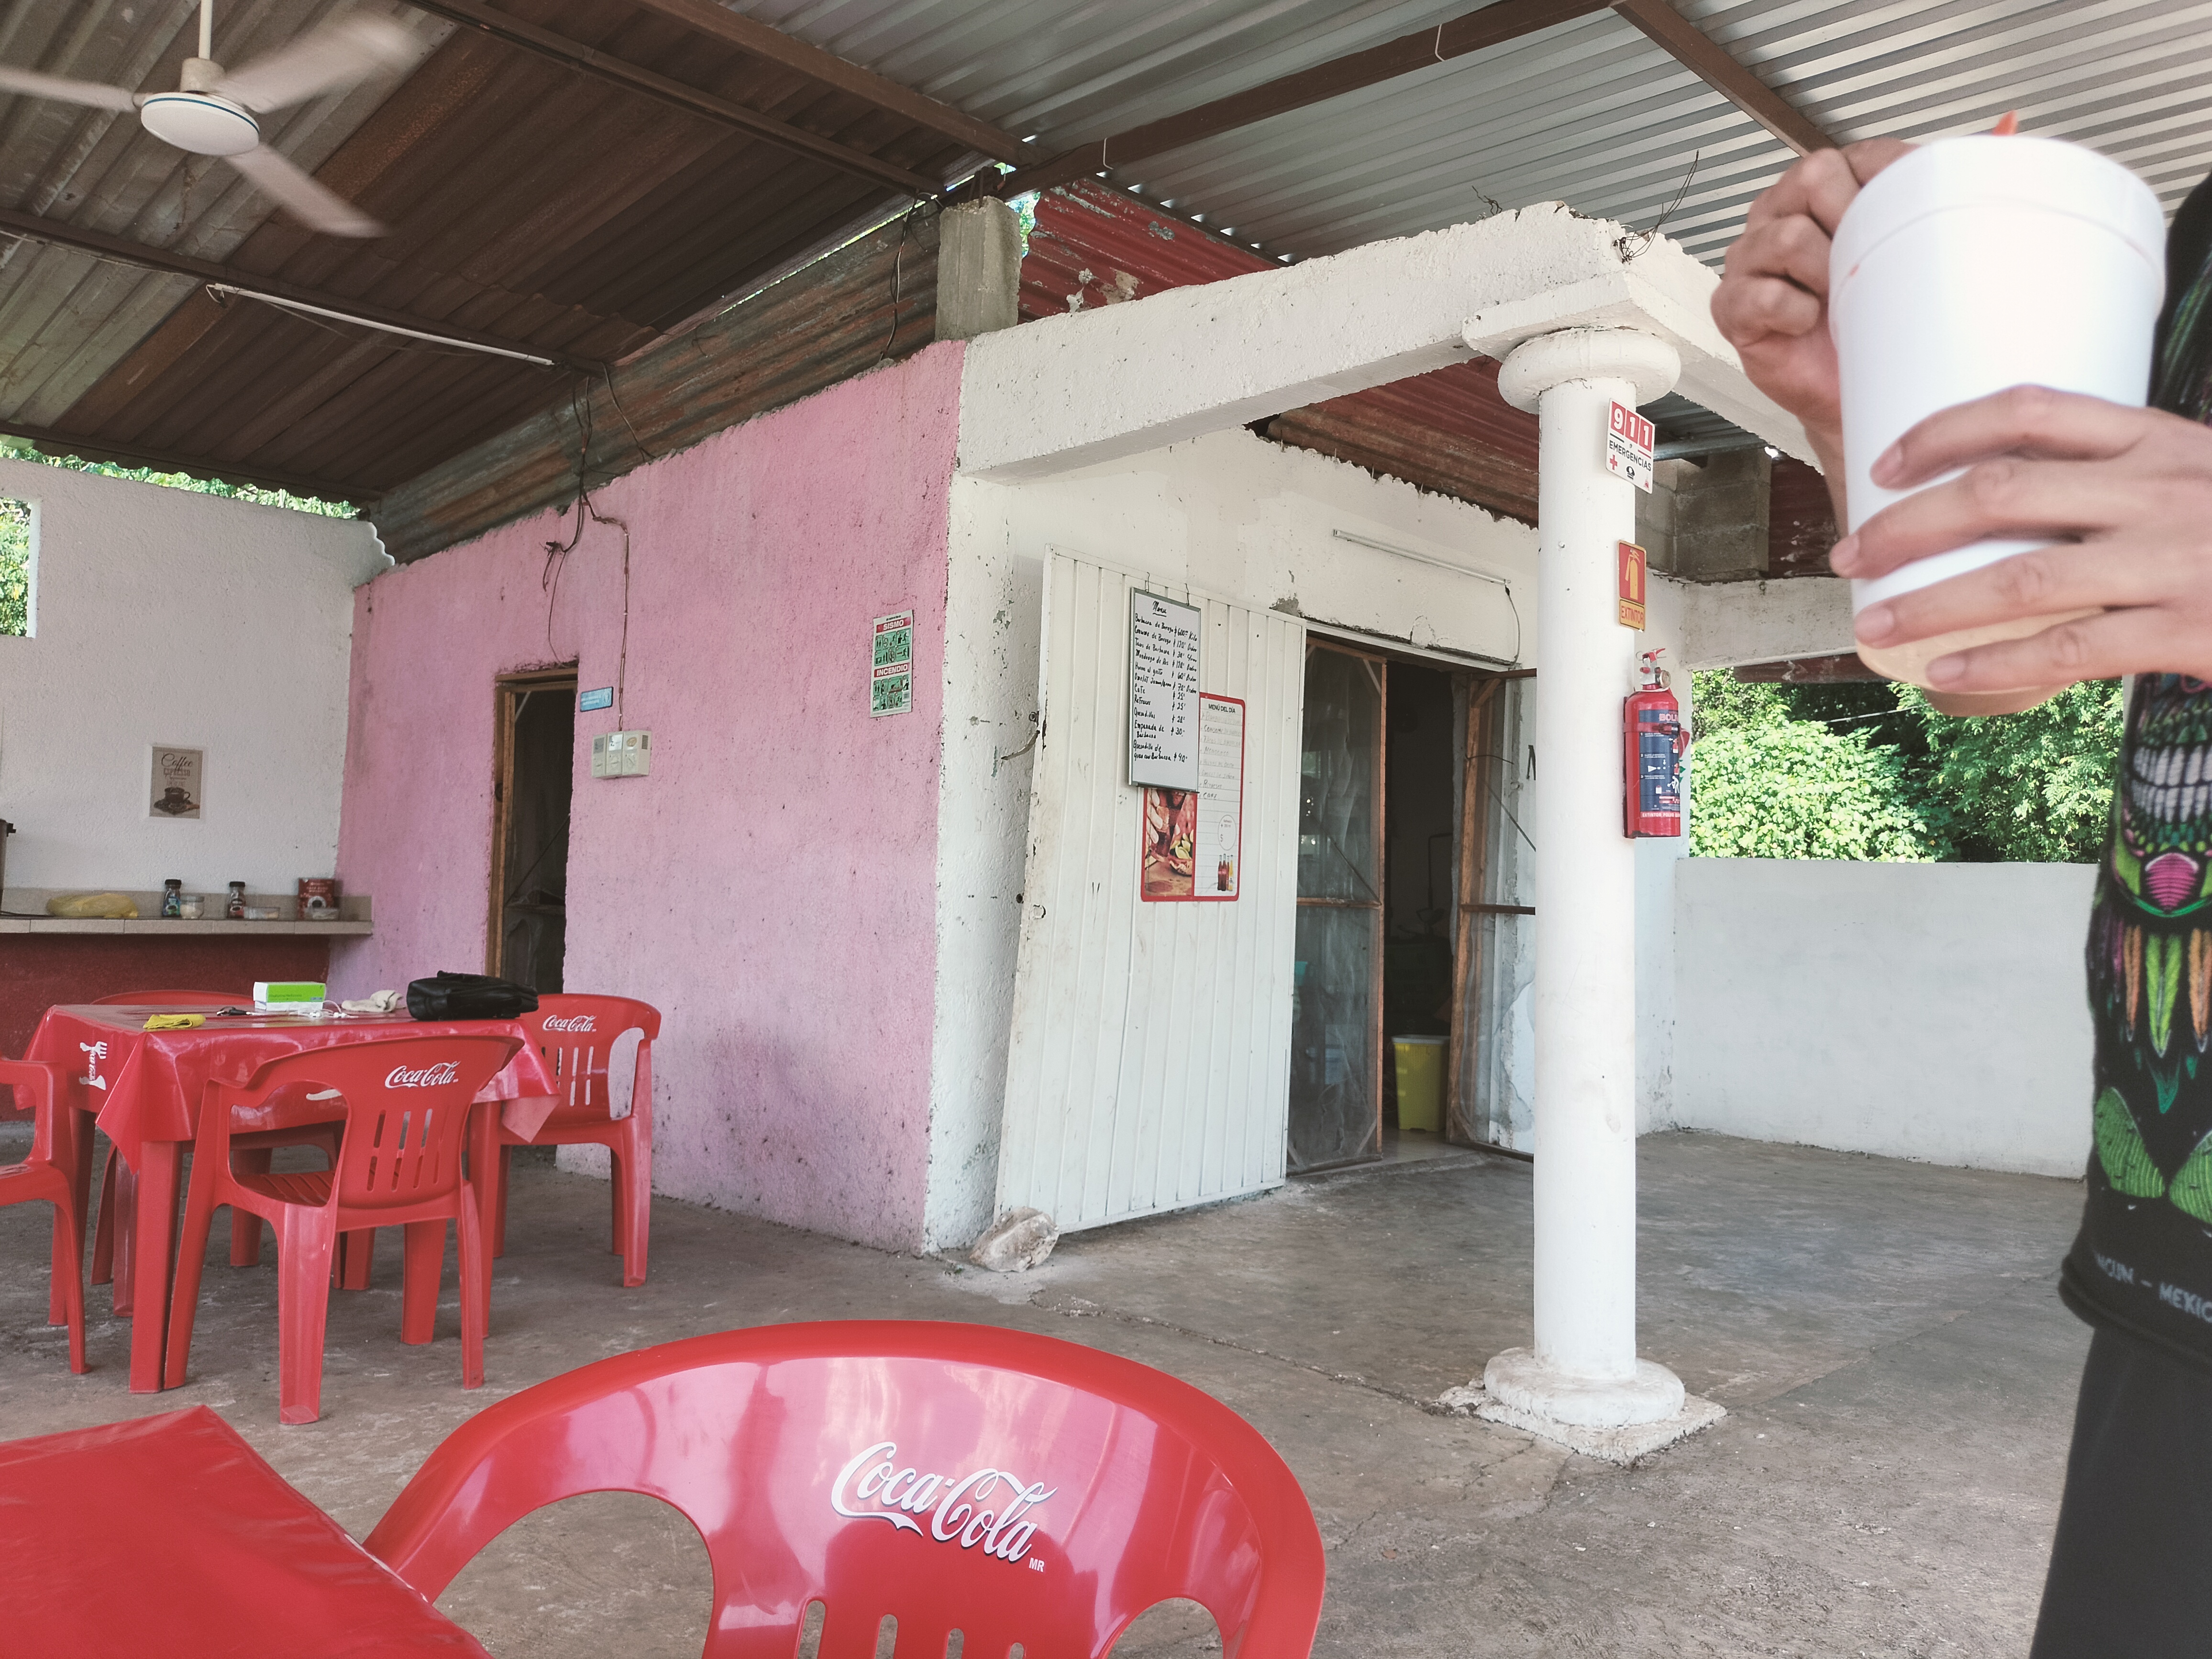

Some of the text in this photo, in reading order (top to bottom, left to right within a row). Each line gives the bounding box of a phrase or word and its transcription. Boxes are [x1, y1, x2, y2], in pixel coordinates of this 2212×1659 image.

[1614, 408, 1649, 446] 911
[1609, 440, 1651, 472] EMERGENCIAS
[1621, 605, 1643, 625] EXTINTOR
[883, 619, 904, 630] SISMO
[1188, 631, 1197, 641] Kilo
[876, 664, 908, 677] INCENDIO
[1159, 724, 1164, 732] de
[161, 753, 193, 771] Coffee
[1029, 1557, 1045, 1573] MR
